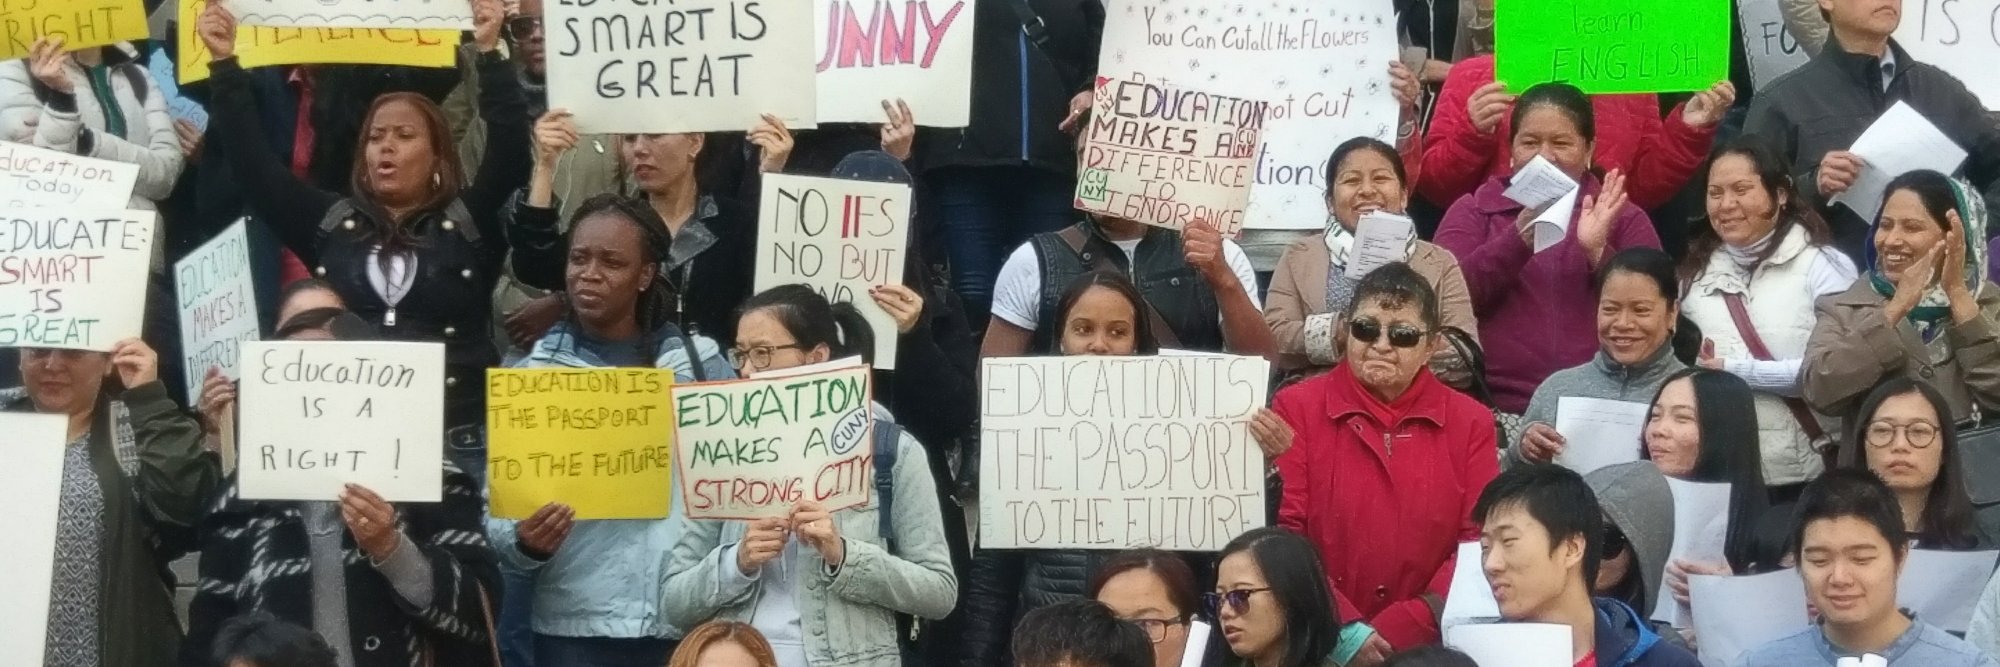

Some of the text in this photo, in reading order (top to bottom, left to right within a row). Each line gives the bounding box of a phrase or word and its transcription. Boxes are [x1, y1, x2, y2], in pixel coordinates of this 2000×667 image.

[5, 6, 122, 56] RIGHT
[560, 1, 767, 56] SMART IS
[1144, 6, 1173, 46] You
[1181, 25, 1216, 49] Can
[1278, 23, 1298, 49] the
[1573, 4, 1642, 35] learn
[596, 54, 753, 99] GREAT
[1552, 42, 1700, 83] ENGLISH
[1115, 81, 1268, 129] EDUCATION
[1304, 87, 1354, 119] Cut
[1092, 115, 1233, 157] MAKES A
[1088, 147, 1247, 187] DIFFERENCE
[10, 173, 84, 204] Today
[1140, 180, 1176, 201] TO
[775, 187, 894, 238] NO IFS
[1103, 189, 1243, 234] IGNORANCE
[0, 254, 104, 285] SMART
[773, 241, 896, 285] NO BUT
[30, 289, 62, 313] IS
[194, 291, 235, 343] MAKES
[490, 371, 661, 397] EDUCATION IS
[677, 373, 867, 428] EDUCATION
[983, 358, 1254, 418] EDUCATION IS
[302, 396, 373, 418] IS A
[488, 404, 657, 430] THE PASSPORT
[691, 427, 829, 469] MAKES A
[834, 409, 869, 449] CUNY
[261, 445, 367, 472] RIGHT
[489, 445, 668, 481] TO THE FUTURE
[982, 421, 1251, 490] THE PASSPORT
[694, 454, 871, 510] STRONG CITY
[1006, 501, 1045, 546] TO
[1051, 498, 1115, 544] THE
